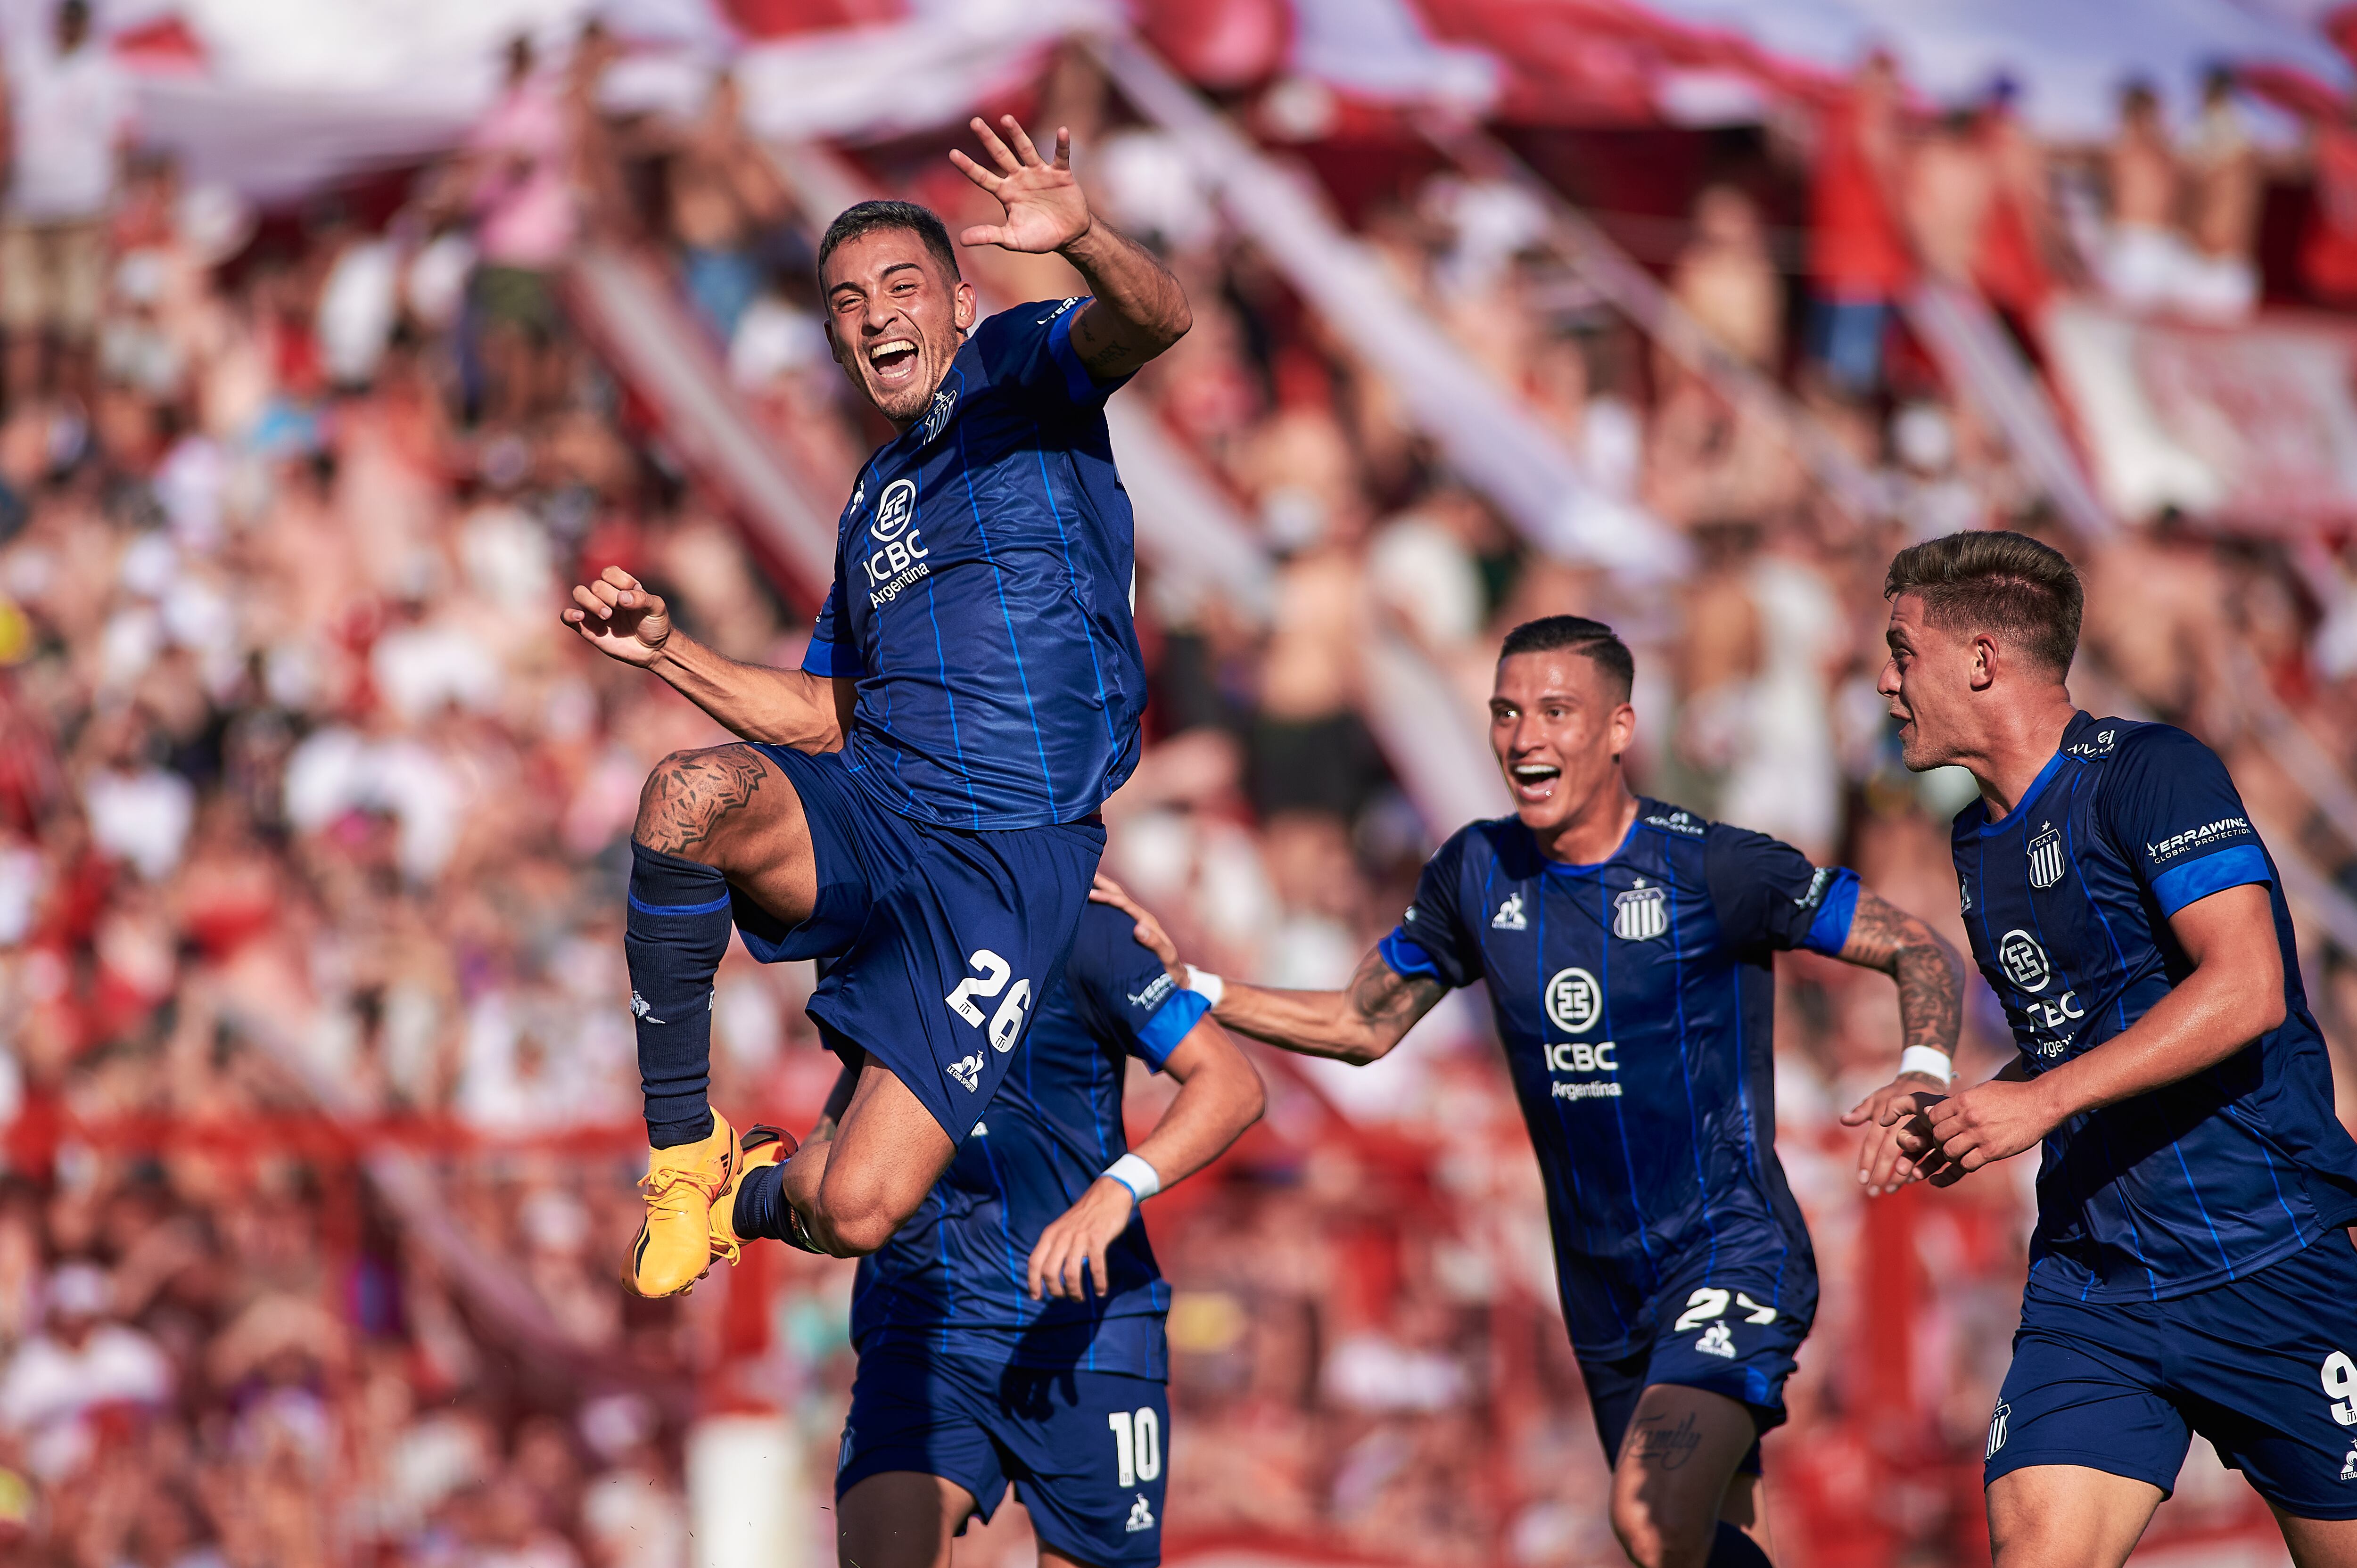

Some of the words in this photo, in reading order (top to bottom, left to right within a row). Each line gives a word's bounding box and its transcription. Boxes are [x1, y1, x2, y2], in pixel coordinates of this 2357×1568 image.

[863, 529, 929, 587] ICBC
[869, 563, 930, 609] Argentina
[2154, 845, 2191, 864] GLOBAL
[945, 949, 1031, 1053] 26
[946, 1066, 955, 1075] LE
[961, 1077, 976, 1093] SPORTIF
[1543, 1041, 1619, 1072] ICBC
[1551, 1080, 1622, 1101] Argentina
[2321, 1351, 2357, 1426] 9
[1108, 1406, 1160, 1487] 10
